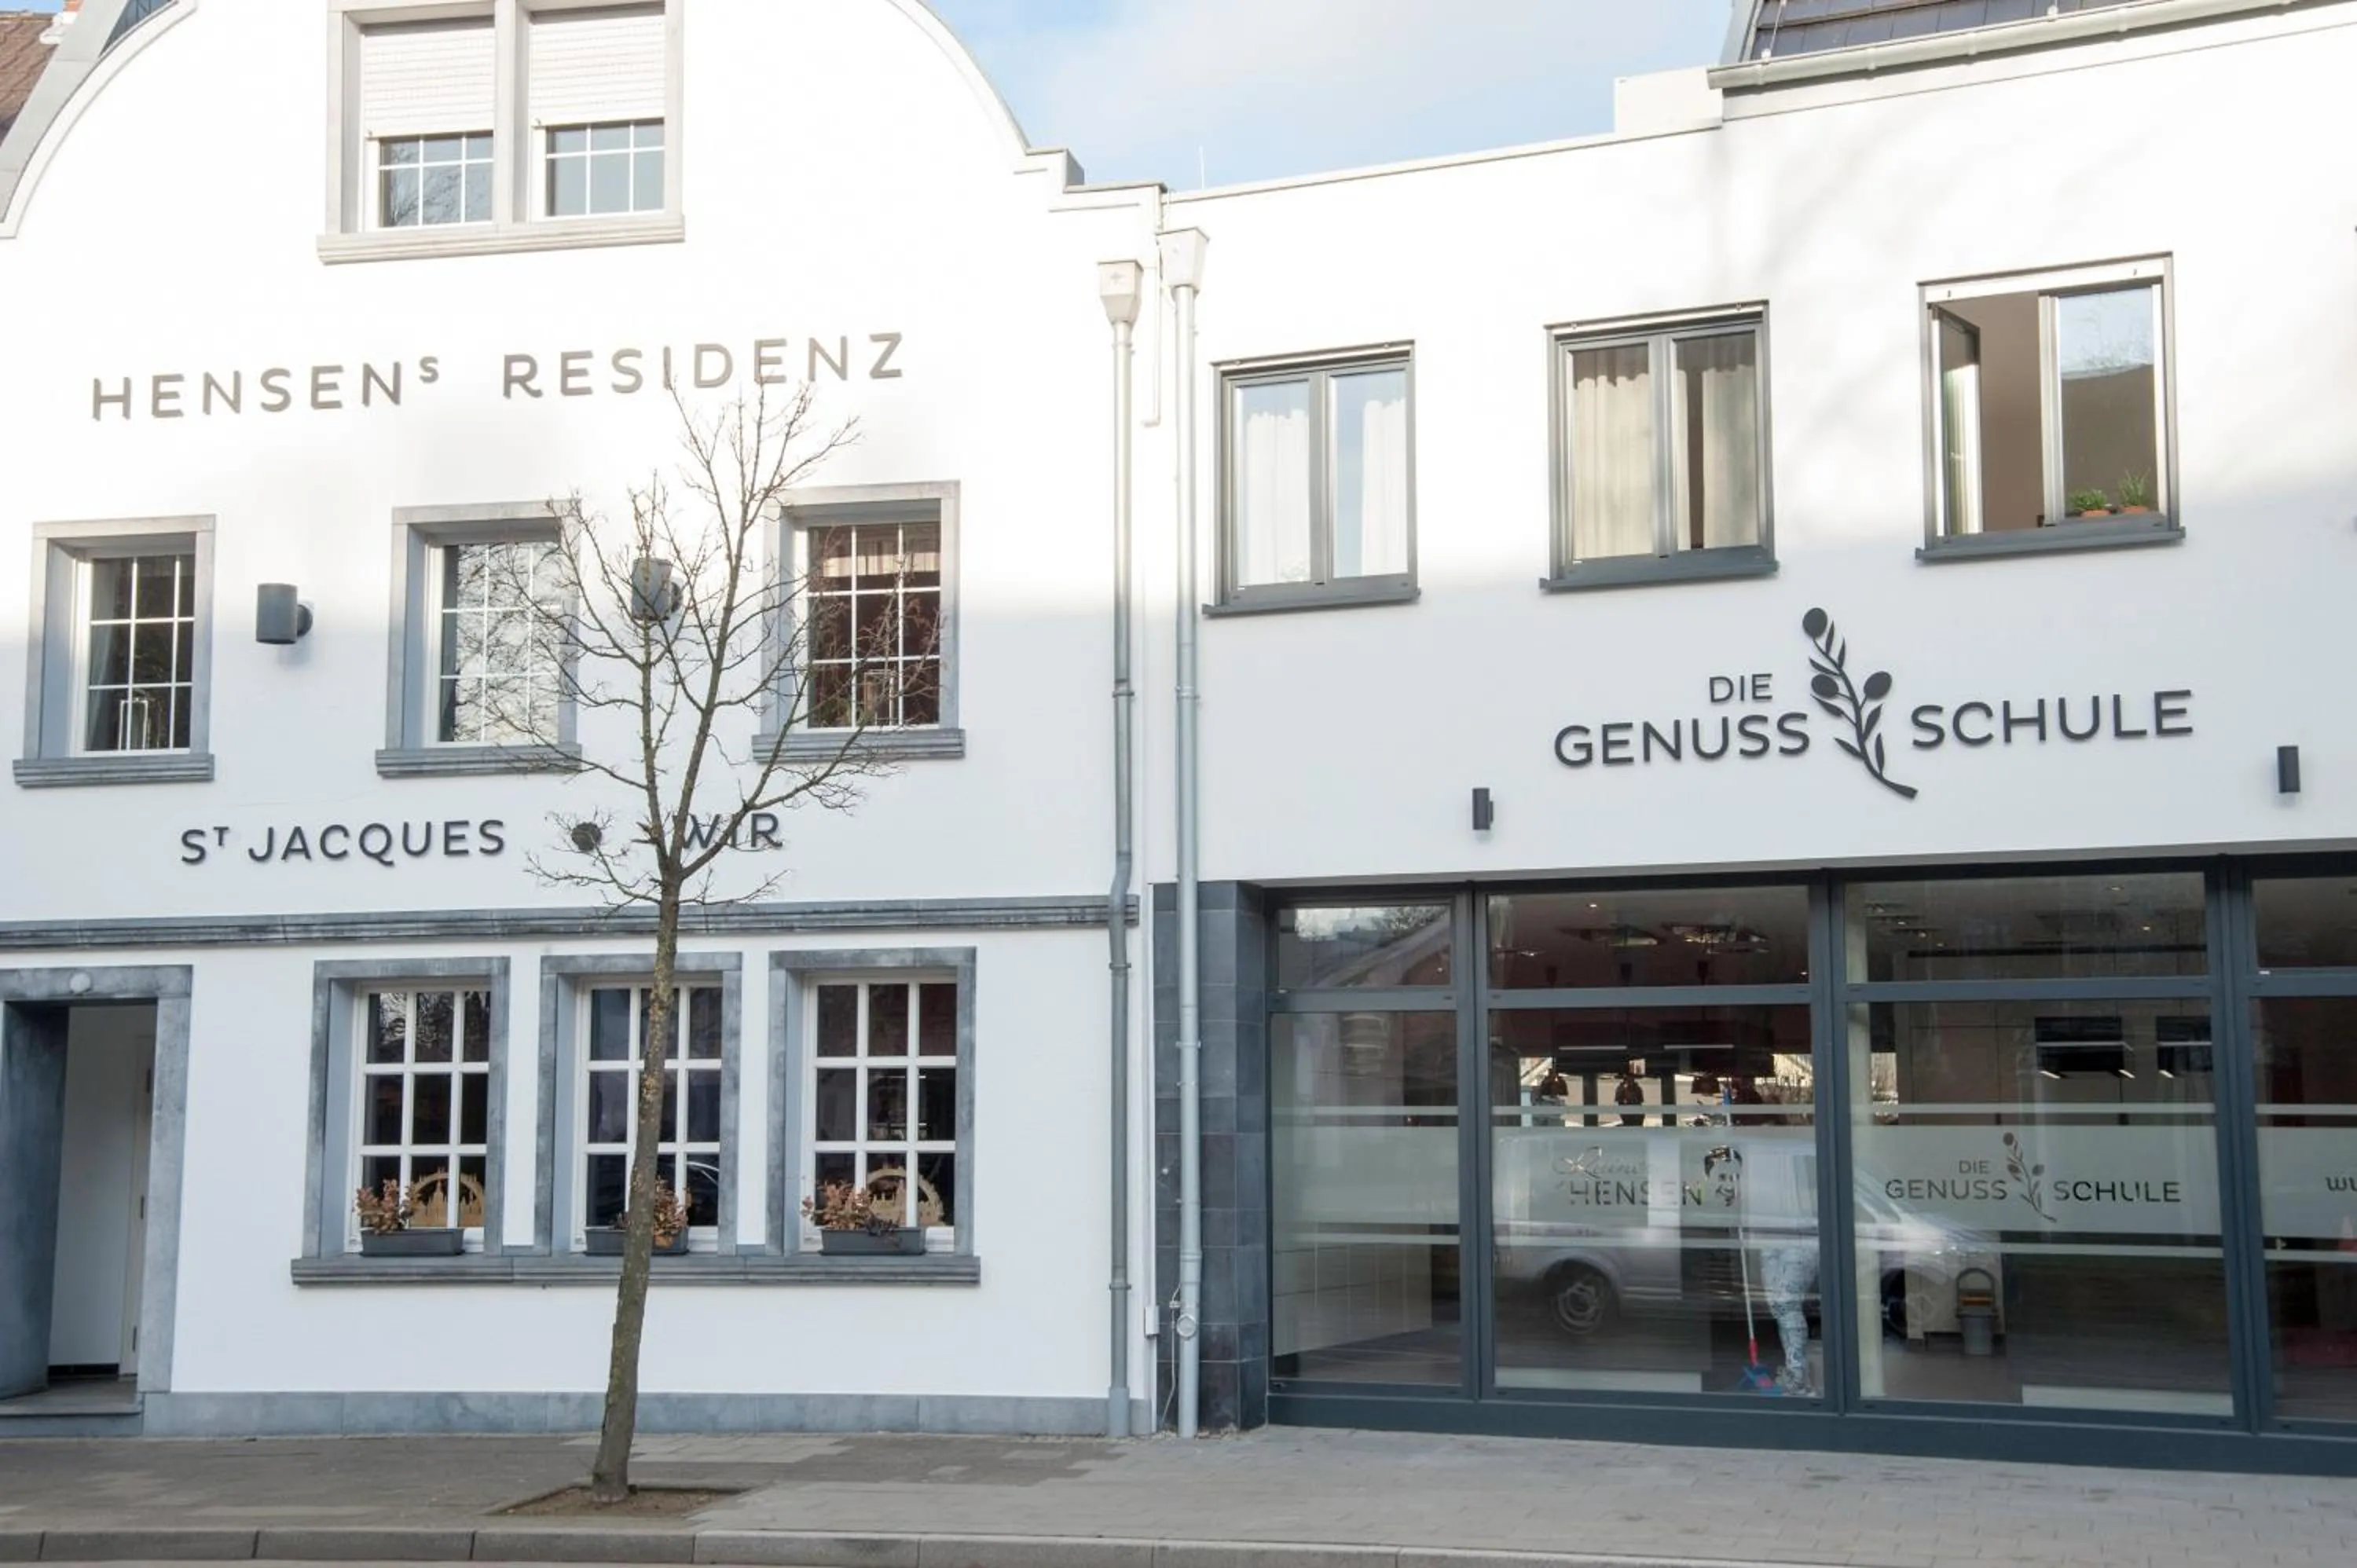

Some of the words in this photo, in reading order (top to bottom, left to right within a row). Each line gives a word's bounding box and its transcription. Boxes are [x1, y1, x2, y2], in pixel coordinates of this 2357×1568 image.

[502, 332, 903, 400] RESIDENZ
[1709, 673, 1773, 704] DIE
[1553, 712, 1810, 769] GENUSS
[1910, 689, 2194, 751] SCHULE
[247, 819, 504, 867] JACQUES
[1959, 1160, 1989, 1175] DIE
[1886, 1178, 2008, 1201] GENUSS
[2054, 1180, 2182, 1203] SCHULE
